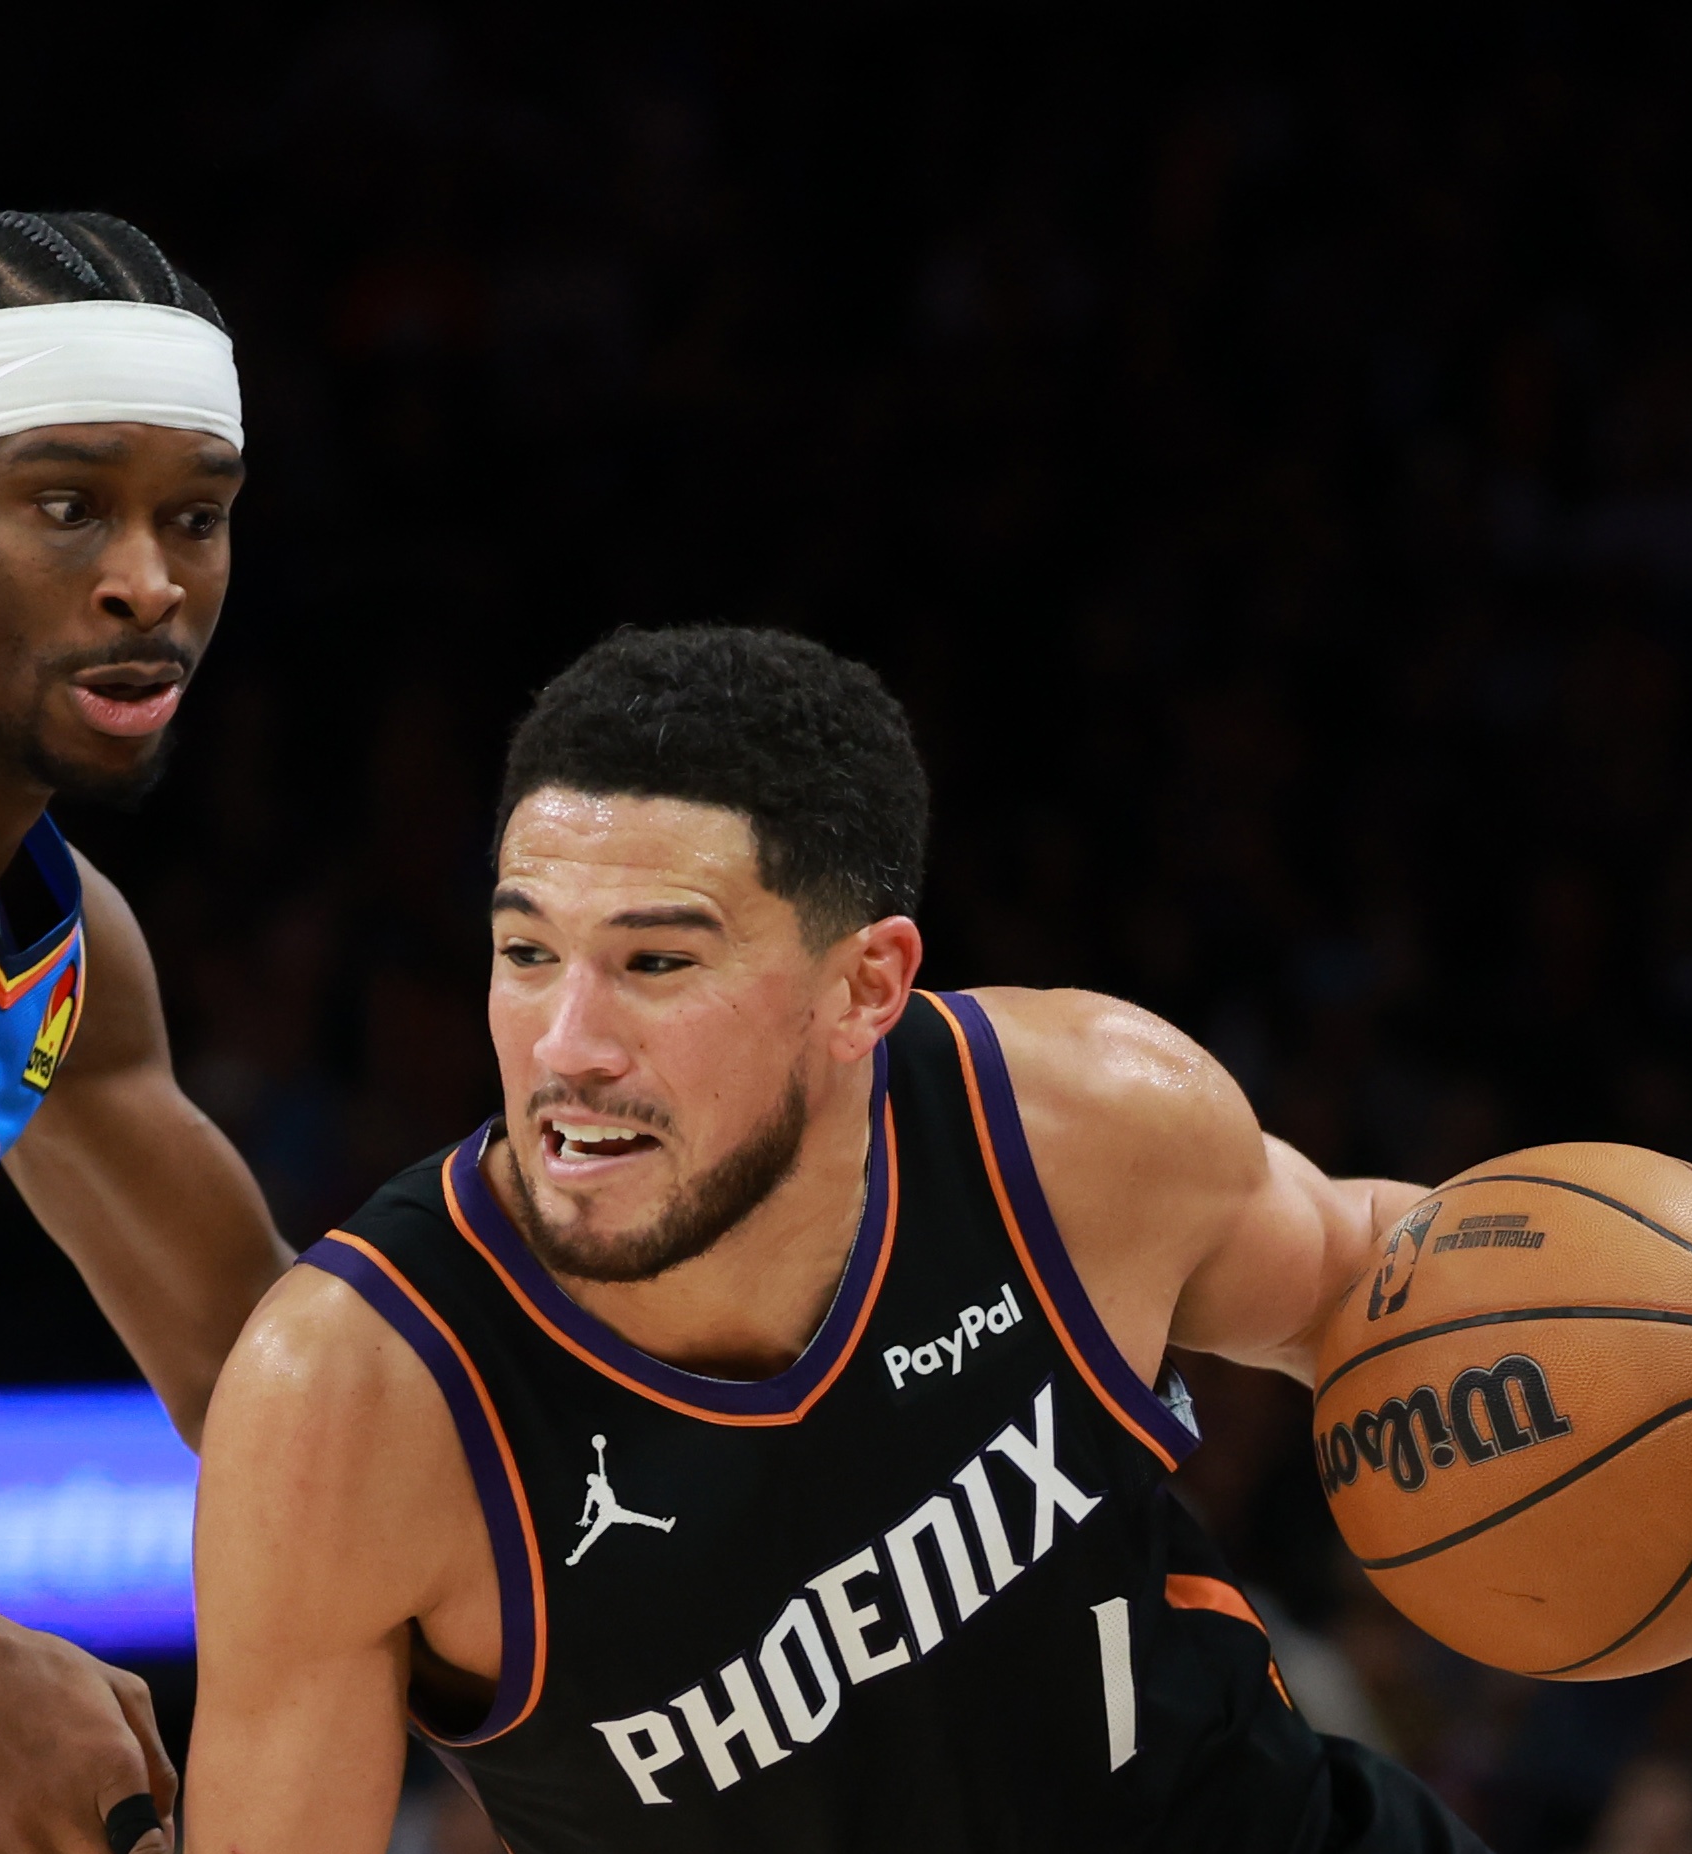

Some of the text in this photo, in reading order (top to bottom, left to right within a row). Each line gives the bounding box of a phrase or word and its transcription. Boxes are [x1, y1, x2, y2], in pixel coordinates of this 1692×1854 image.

[1493, 1230, 1545, 1249] OFFICIAL
[883, 1283, 1023, 1389] PayPal
[1317, 1353, 1573, 1499] Wilson
[591, 1382, 1103, 1804] PHOENIX
[1089, 1597, 1138, 1772] 1
